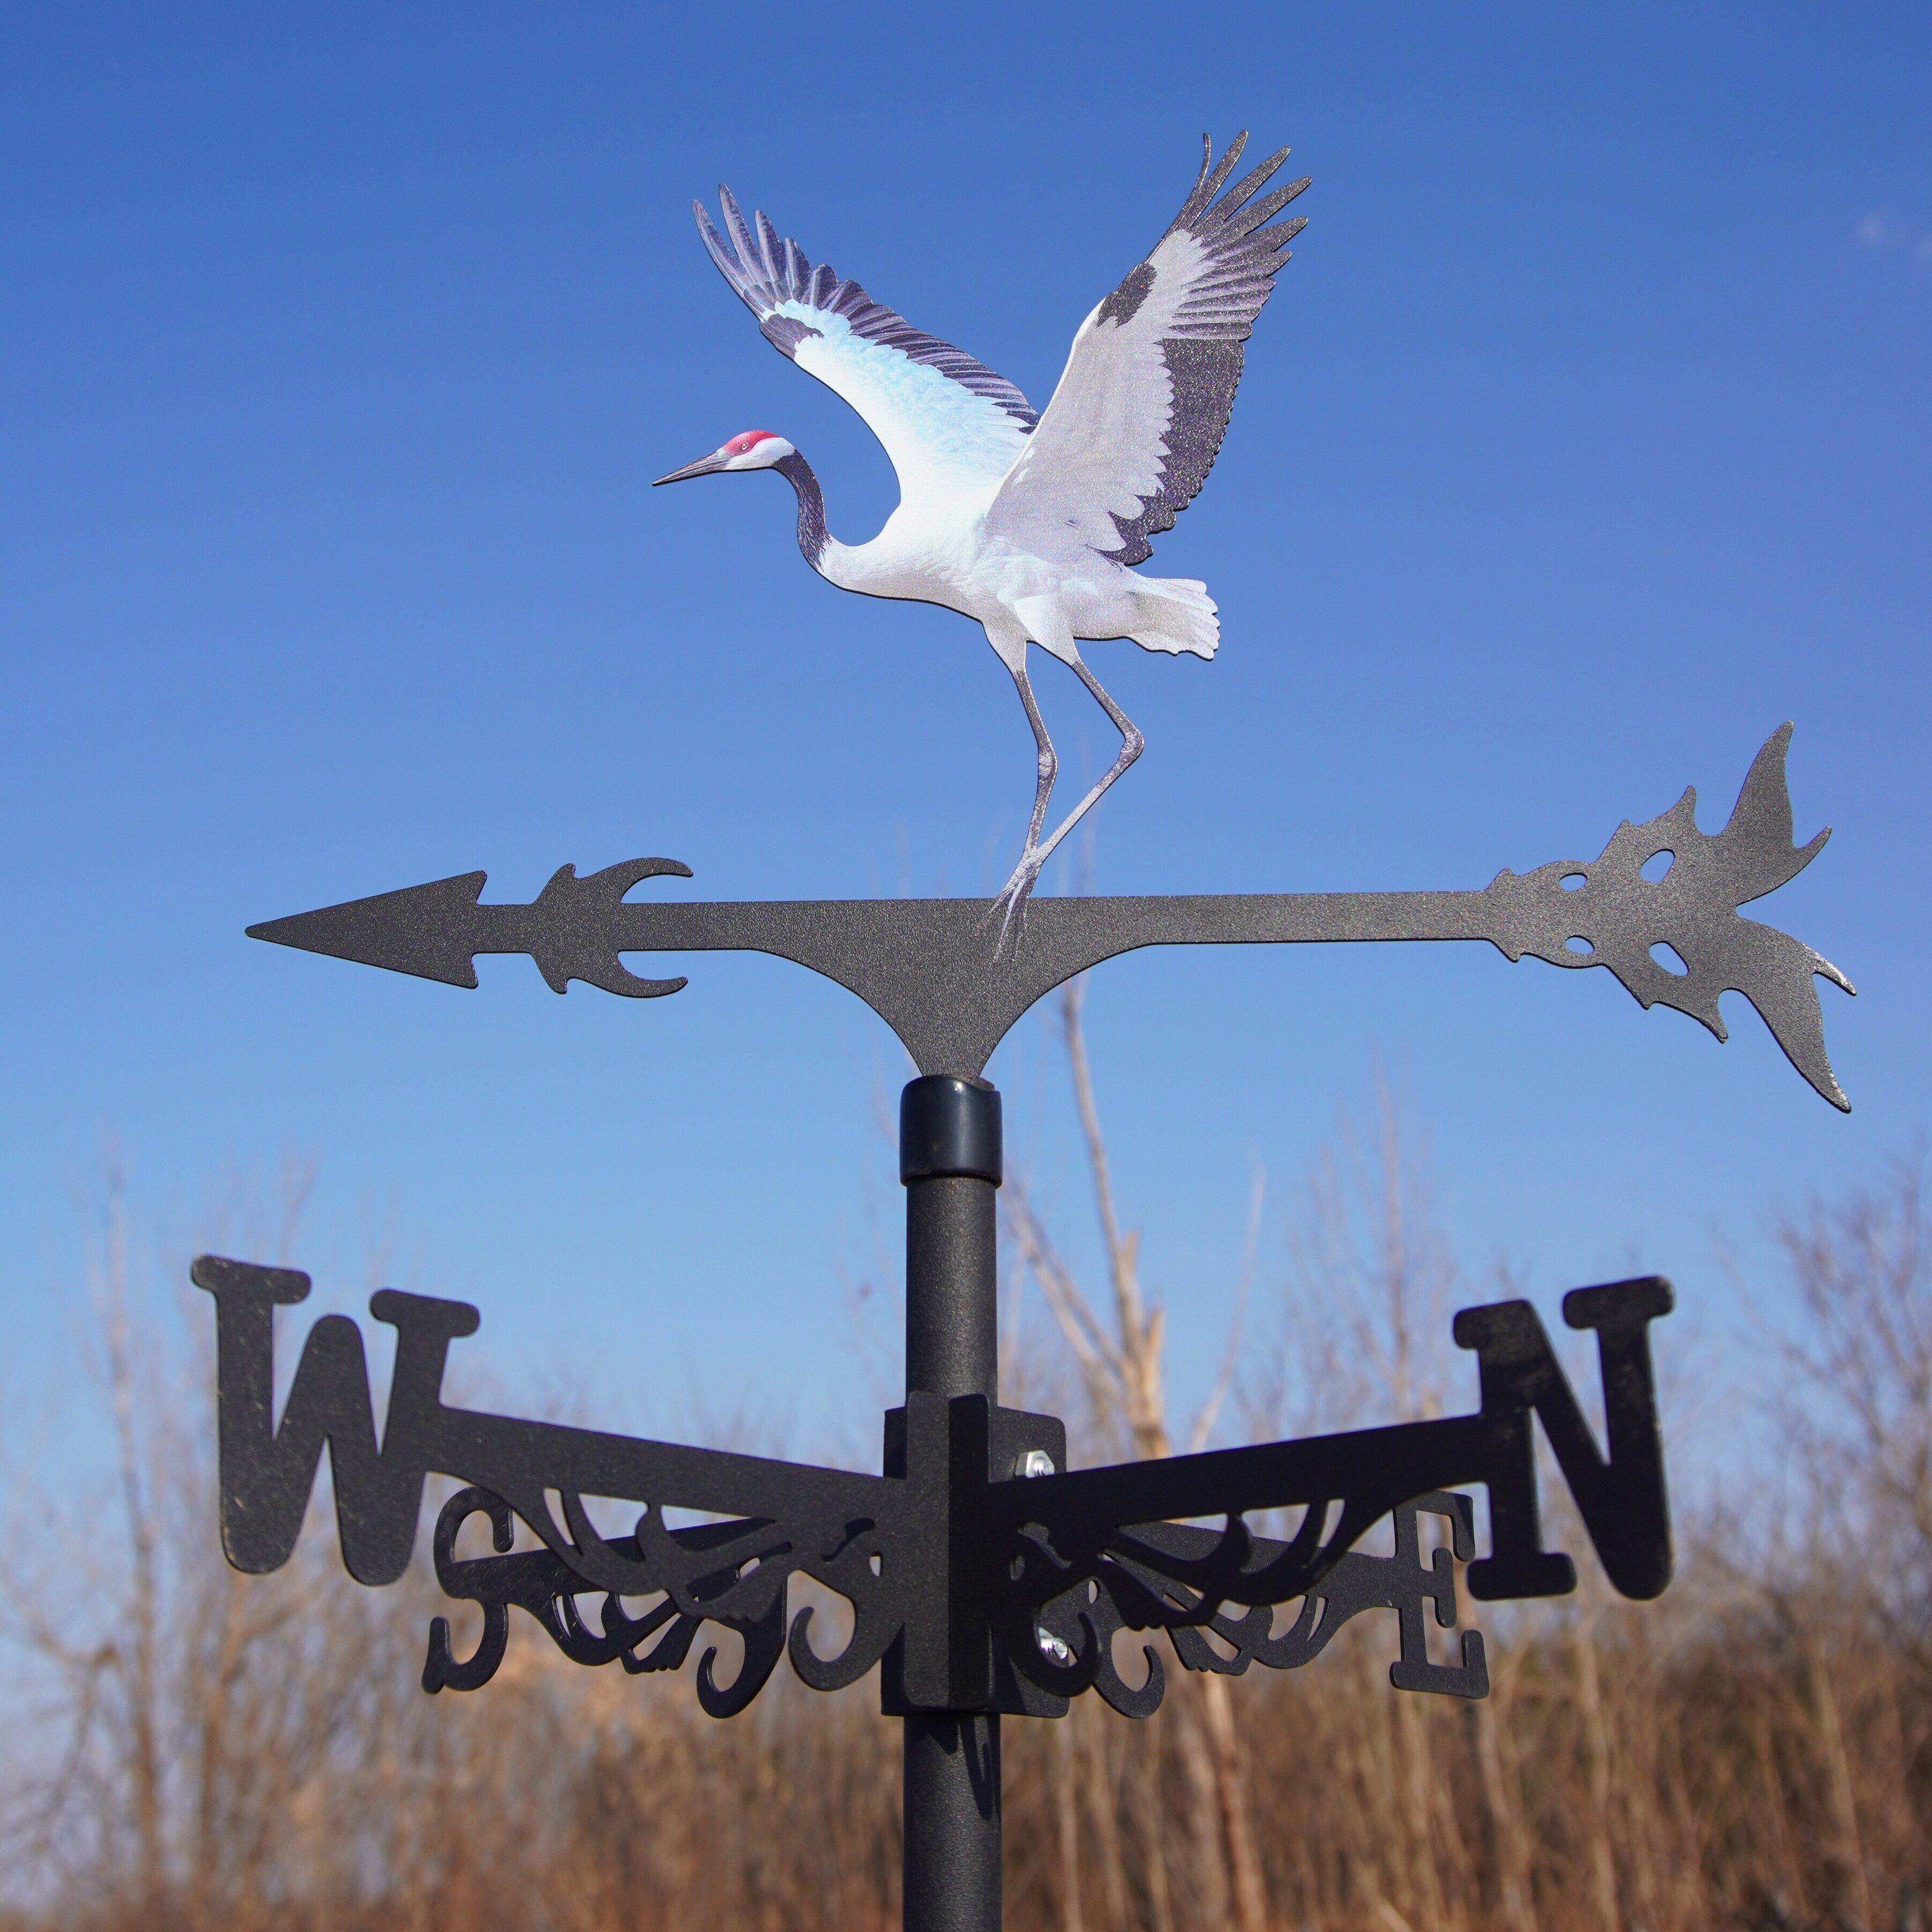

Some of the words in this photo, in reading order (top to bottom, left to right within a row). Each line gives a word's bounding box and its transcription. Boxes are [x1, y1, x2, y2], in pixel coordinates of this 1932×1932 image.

[191, 1255, 480, 1586] W
[1453, 1275, 1675, 1600] N
[422, 1486, 514, 1694] S
[1389, 1490, 1490, 1699] E
